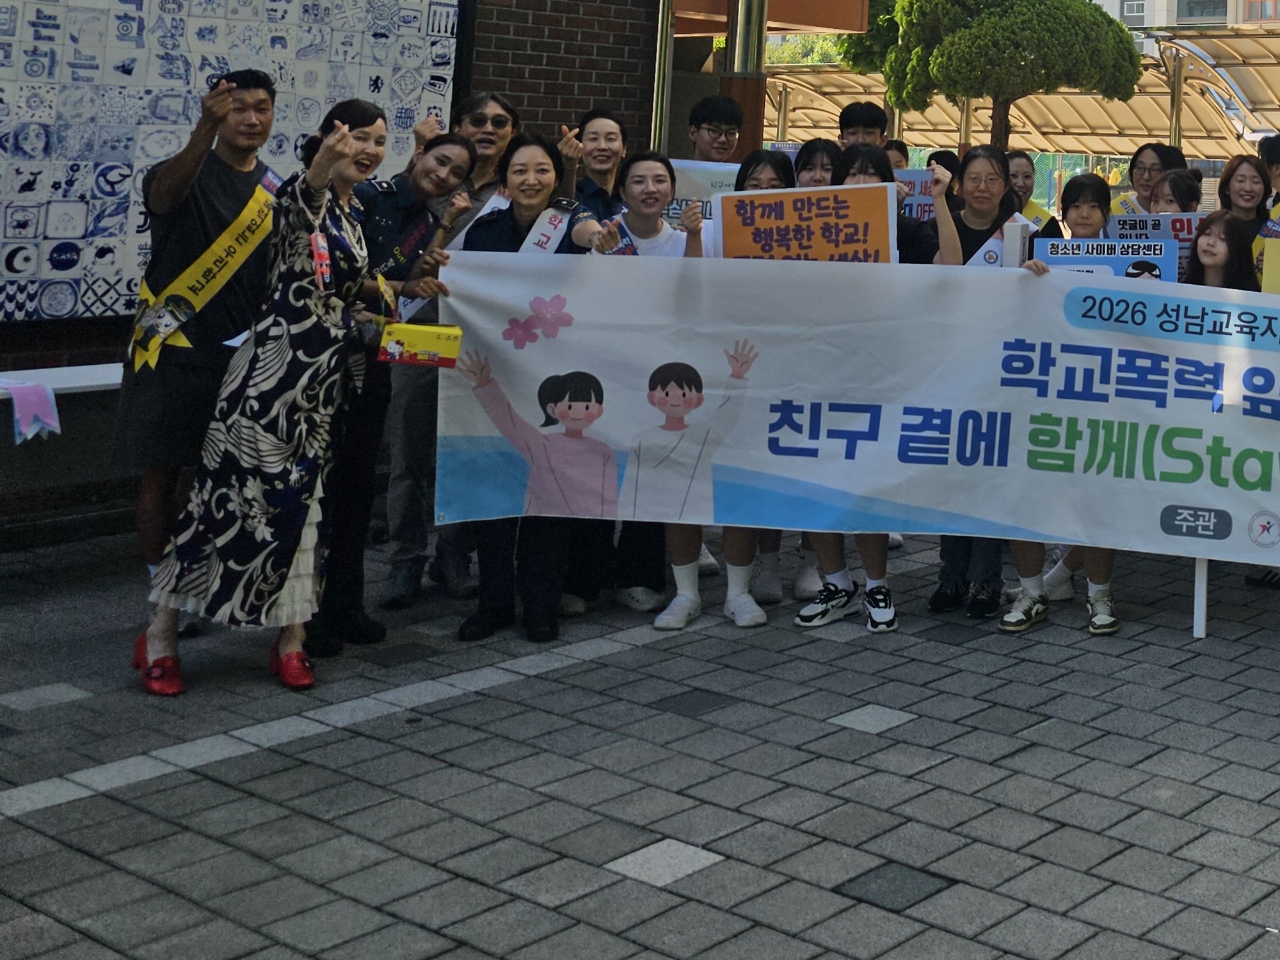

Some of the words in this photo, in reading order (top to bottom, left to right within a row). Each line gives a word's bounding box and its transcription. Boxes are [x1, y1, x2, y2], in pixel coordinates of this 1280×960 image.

[734, 199, 784, 227] 함께
[793, 194, 850, 222] 만드는
[1117, 218, 1148, 231] 댓글이
[1150, 218, 1162, 231] 곧
[751, 223, 815, 254] 행복한
[820, 221, 869, 248] 학교!
[1049, 242, 1081, 256] 청소년
[1084, 242, 1116, 256] 사이버
[1119, 242, 1163, 256] 상담센터
[1081, 295, 1147, 326] 2026
[1000, 338, 1225, 414] 학교폭력
[768, 399, 882, 460] 친구
[897, 406, 1012, 467] 곁에
[1174, 508, 1217, 535] 주관
